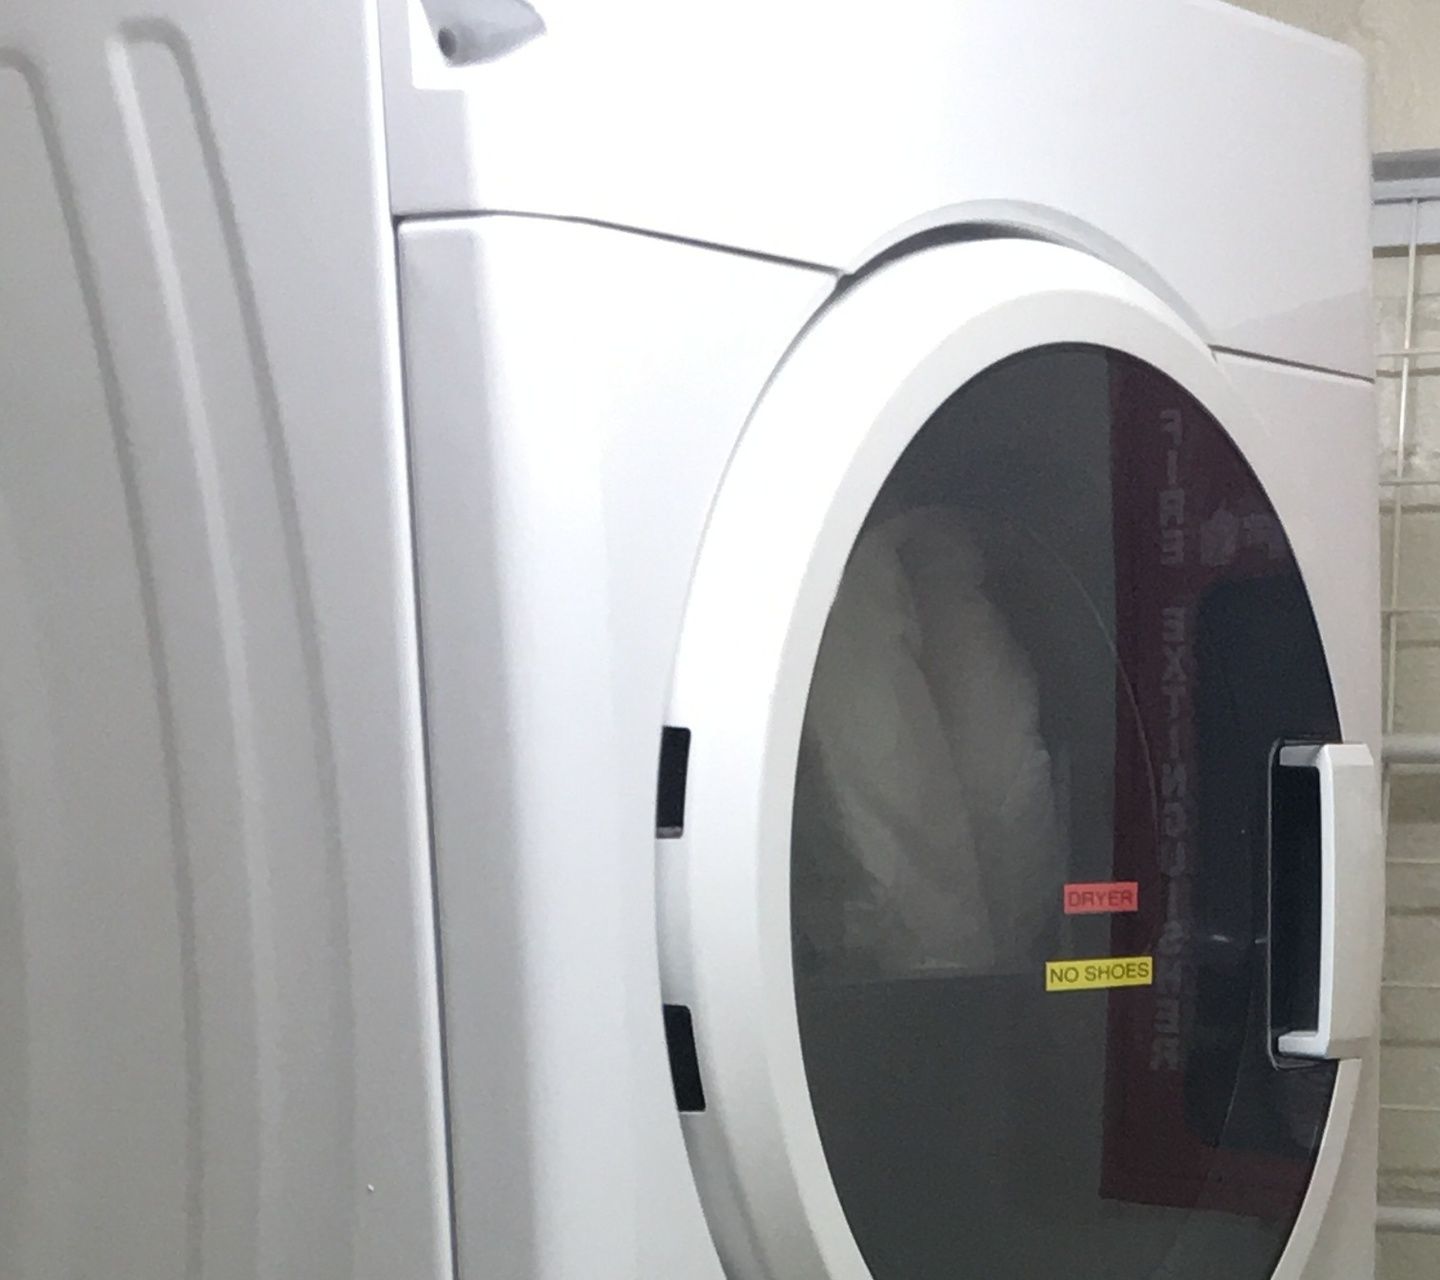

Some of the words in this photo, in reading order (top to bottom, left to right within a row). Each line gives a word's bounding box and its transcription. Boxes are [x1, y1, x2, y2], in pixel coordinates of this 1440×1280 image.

[1067, 889, 1134, 908] DRYER
[1050, 966, 1080, 984] NO
[1084, 961, 1150, 982] SHOES
